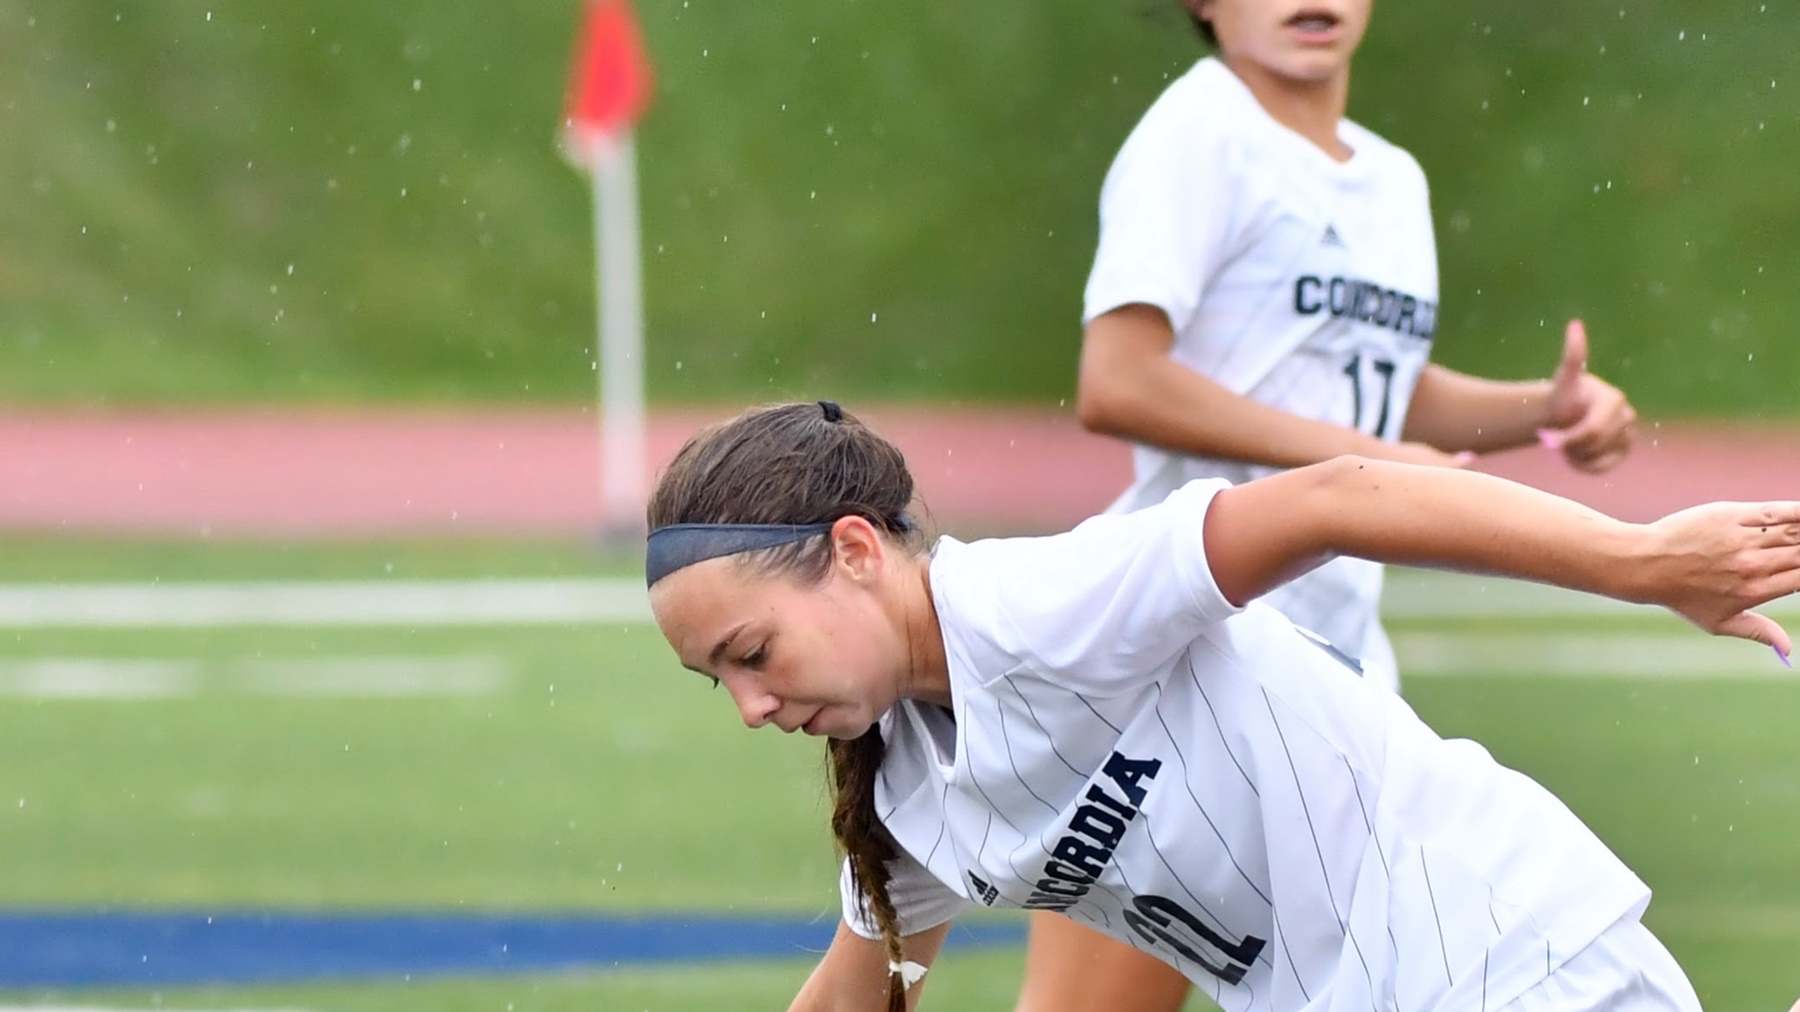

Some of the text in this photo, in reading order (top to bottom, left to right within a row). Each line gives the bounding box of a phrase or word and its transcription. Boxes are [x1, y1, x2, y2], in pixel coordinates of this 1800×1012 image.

[1344, 355, 1396, 438] 17
[1021, 750, 1162, 912] NCORDIA
[1123, 895, 1267, 987] 22
